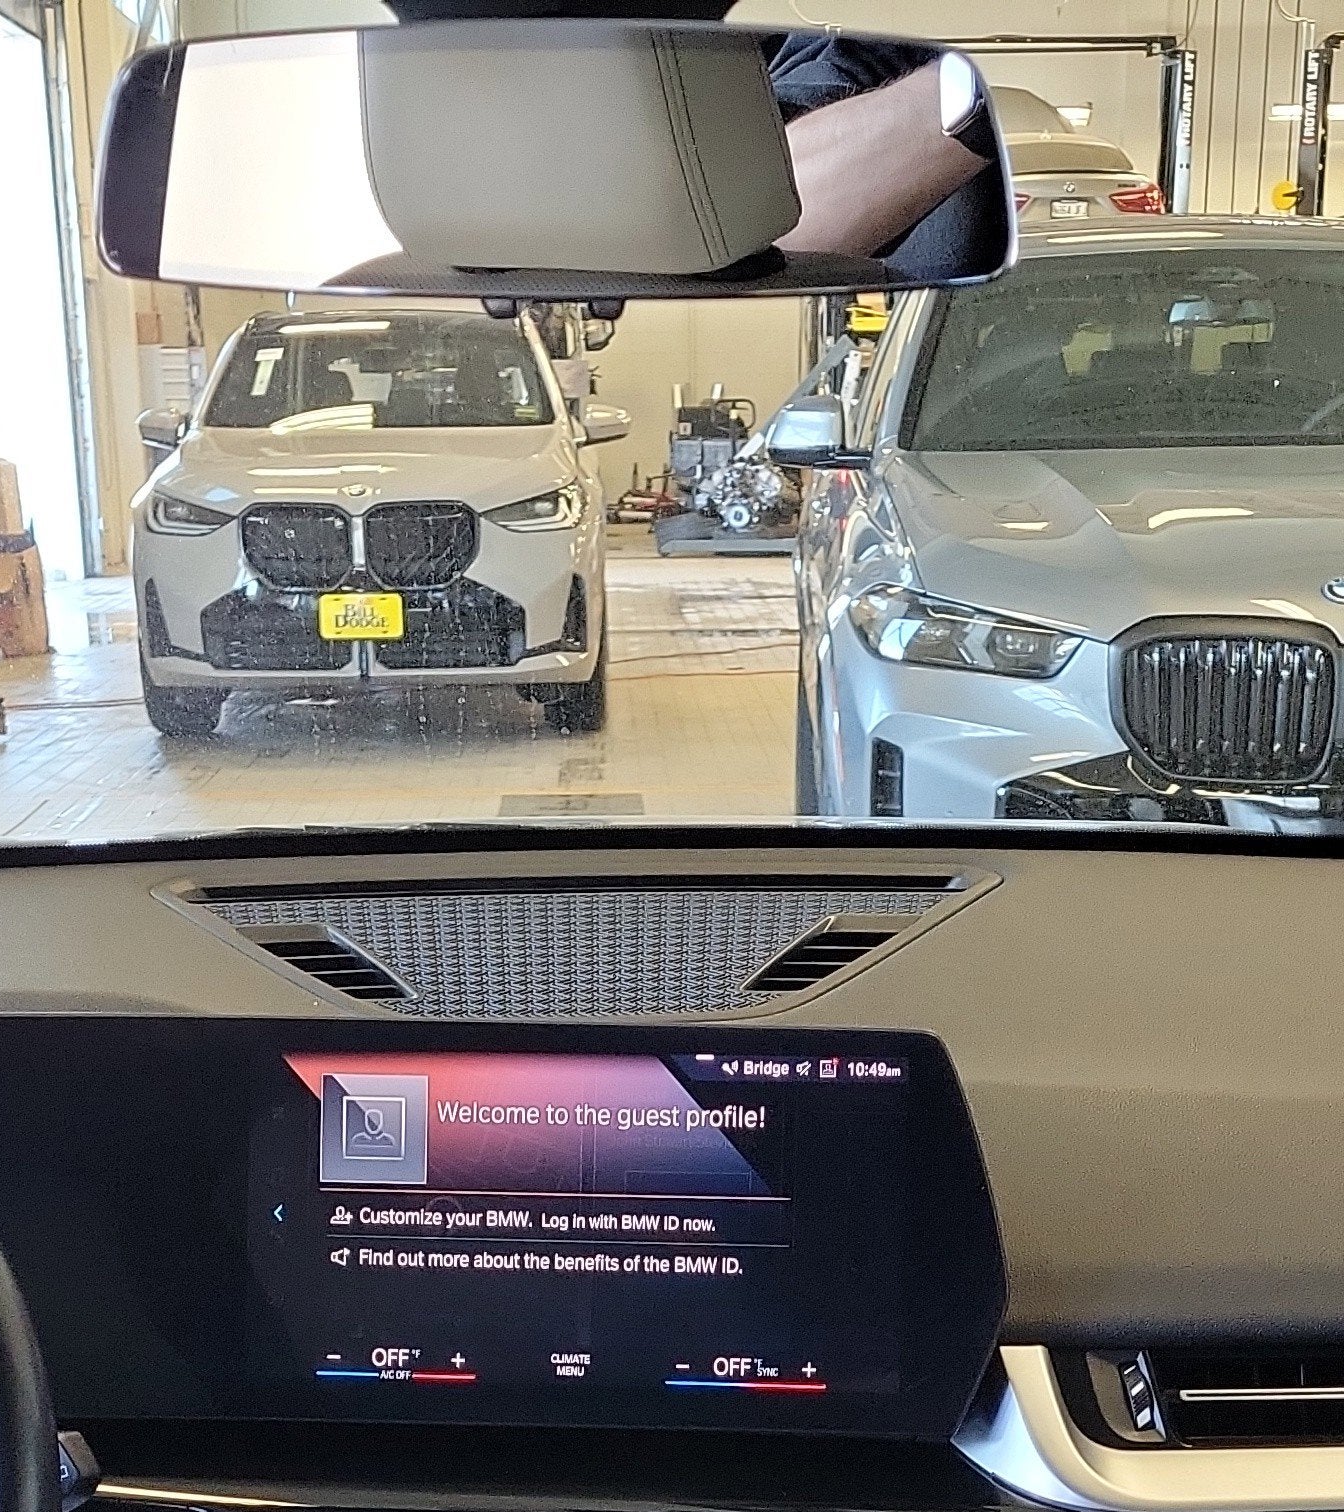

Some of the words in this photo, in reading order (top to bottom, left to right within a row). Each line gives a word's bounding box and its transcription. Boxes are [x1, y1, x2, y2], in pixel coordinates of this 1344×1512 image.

[1183, 51, 1195, 81] LIFT
[1306, 51, 1319, 80] LIFT
[1303, 83, 1317, 137] ROTARY
[743, 1060, 790, 1077] Bridge
[847, 1062, 901, 1077] 10:49am
[437, 1100, 540, 1125] Welcome
[546, 1104, 569, 1125] to
[574, 1103, 610, 1126] the
[617, 1107, 680, 1131] guest
[685, 1105, 766, 1131] profile!
[359, 1207, 443, 1225] Customize
[445, 1211, 483, 1229] your
[486, 1210, 533, 1228] BMW.
[541, 1213, 569, 1231] Log
[572, 1213, 586, 1229] in
[588, 1213, 618, 1230] with
[621, 1214, 660, 1231] BMW
[663, 1215, 680, 1231] ID
[683, 1218, 716, 1232] now.
[359, 1248, 394, 1266] Find
[397, 1251, 425, 1267] out
[428, 1254, 470, 1268] more
[473, 1252, 521, 1269] about
[523, 1252, 550, 1270] the
[554, 1253, 620, 1272] benefits
[623, 1254, 641, 1272] of
[643, 1255, 670, 1273] the
[674, 1256, 718, 1274] BMW
[721, 1257, 743, 1275] ID.
[371, 1347, 410, 1368] OFF
[550, 1353, 591, 1365] CLIMATE
[713, 1357, 752, 1377] OFF
[396, 1370, 411, 1380] OFF
[556, 1365, 585, 1377] MENU
[756, 1367, 779, 1377] SYNC
